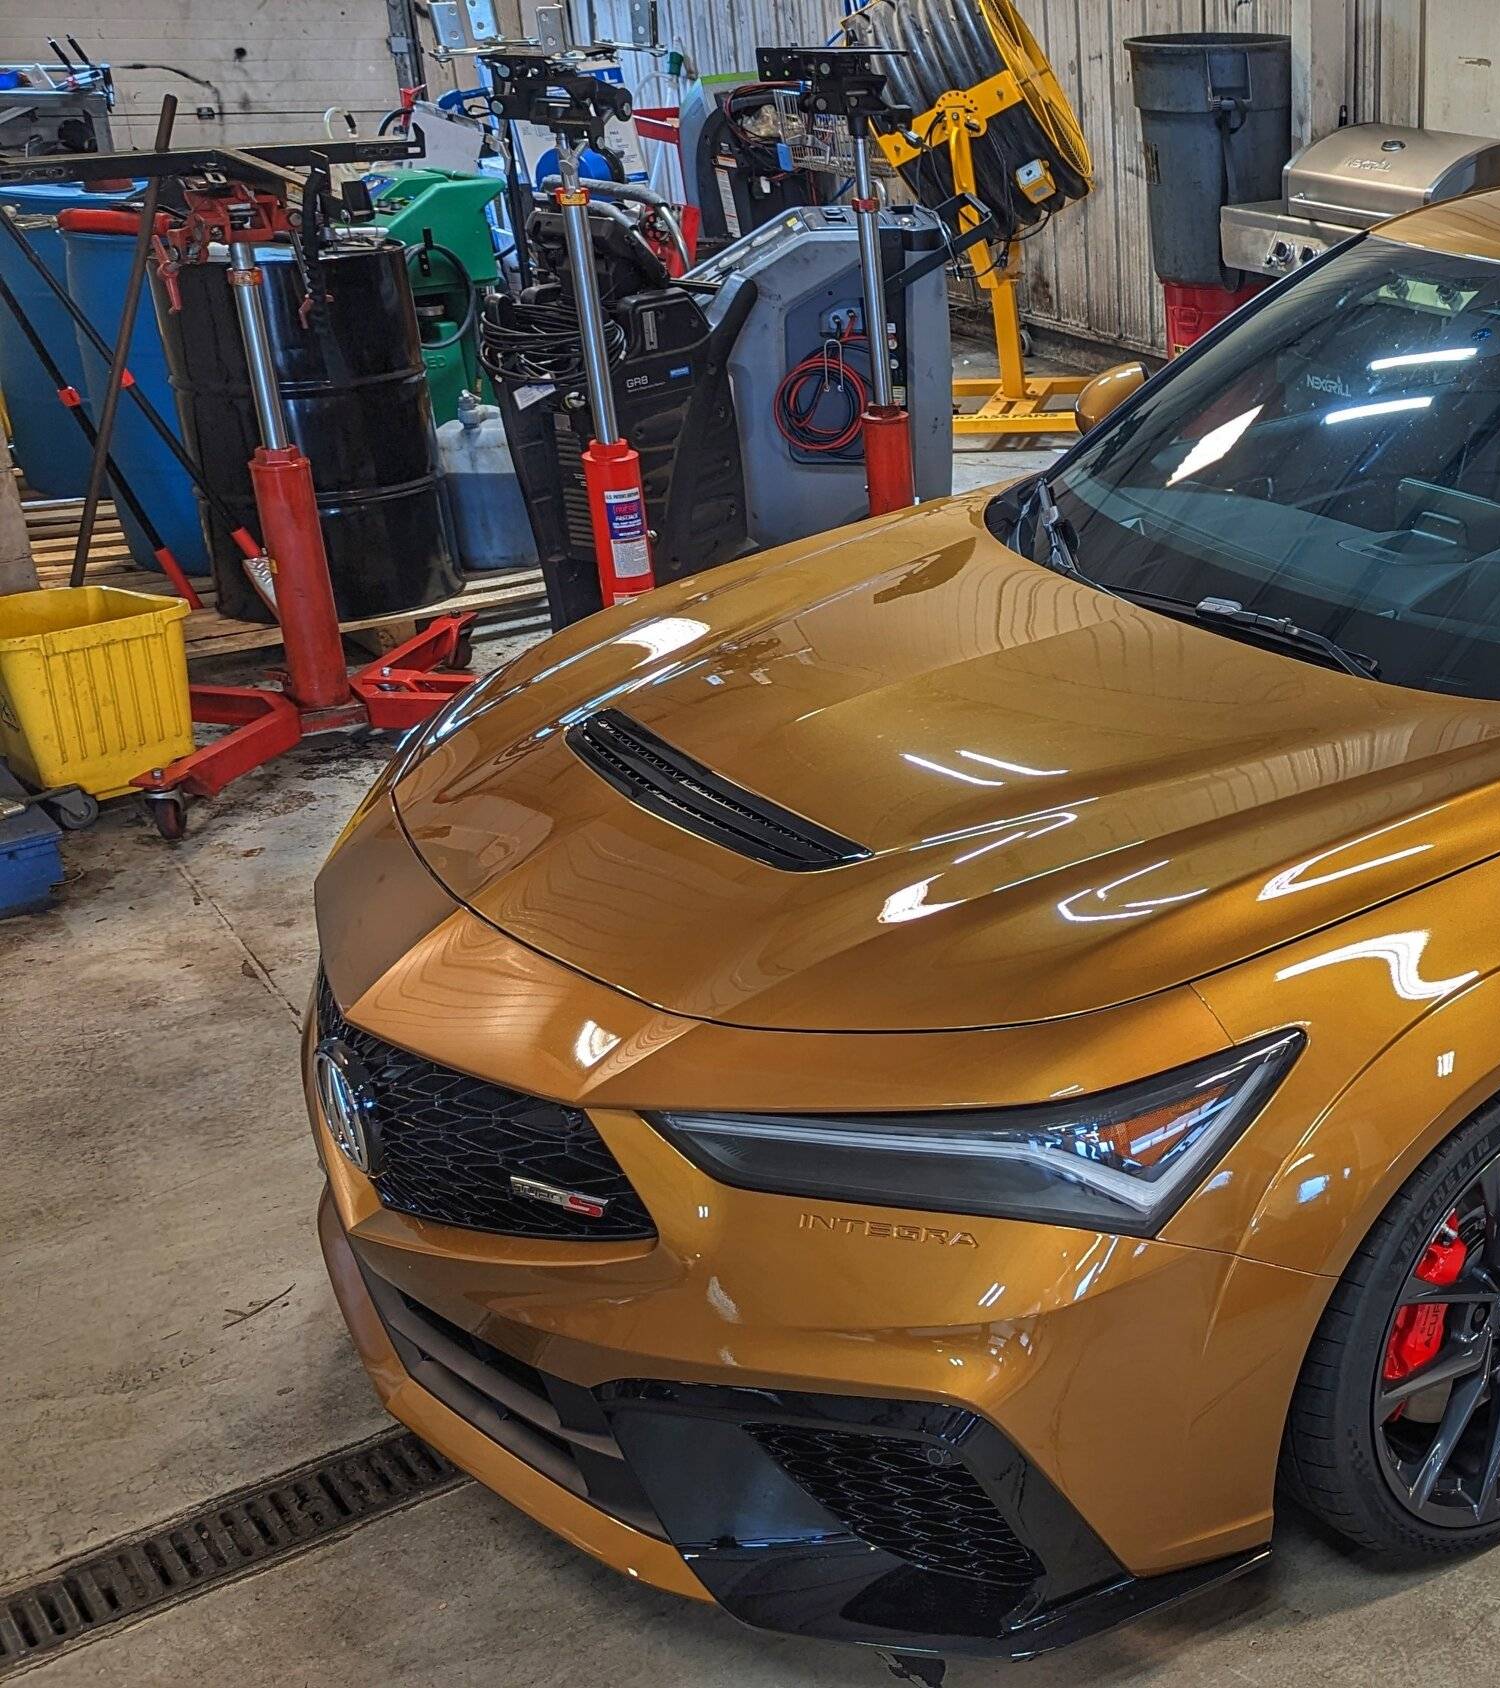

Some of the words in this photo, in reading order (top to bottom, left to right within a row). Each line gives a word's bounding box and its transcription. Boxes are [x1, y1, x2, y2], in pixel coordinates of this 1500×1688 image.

[1306, 374, 1352, 398] NEXGRILL
[1402, 1136, 1491, 1255] MICHELIN
[799, 1213, 980, 1249] INTEGRA
[1424, 1303, 1441, 1348] ACUR
